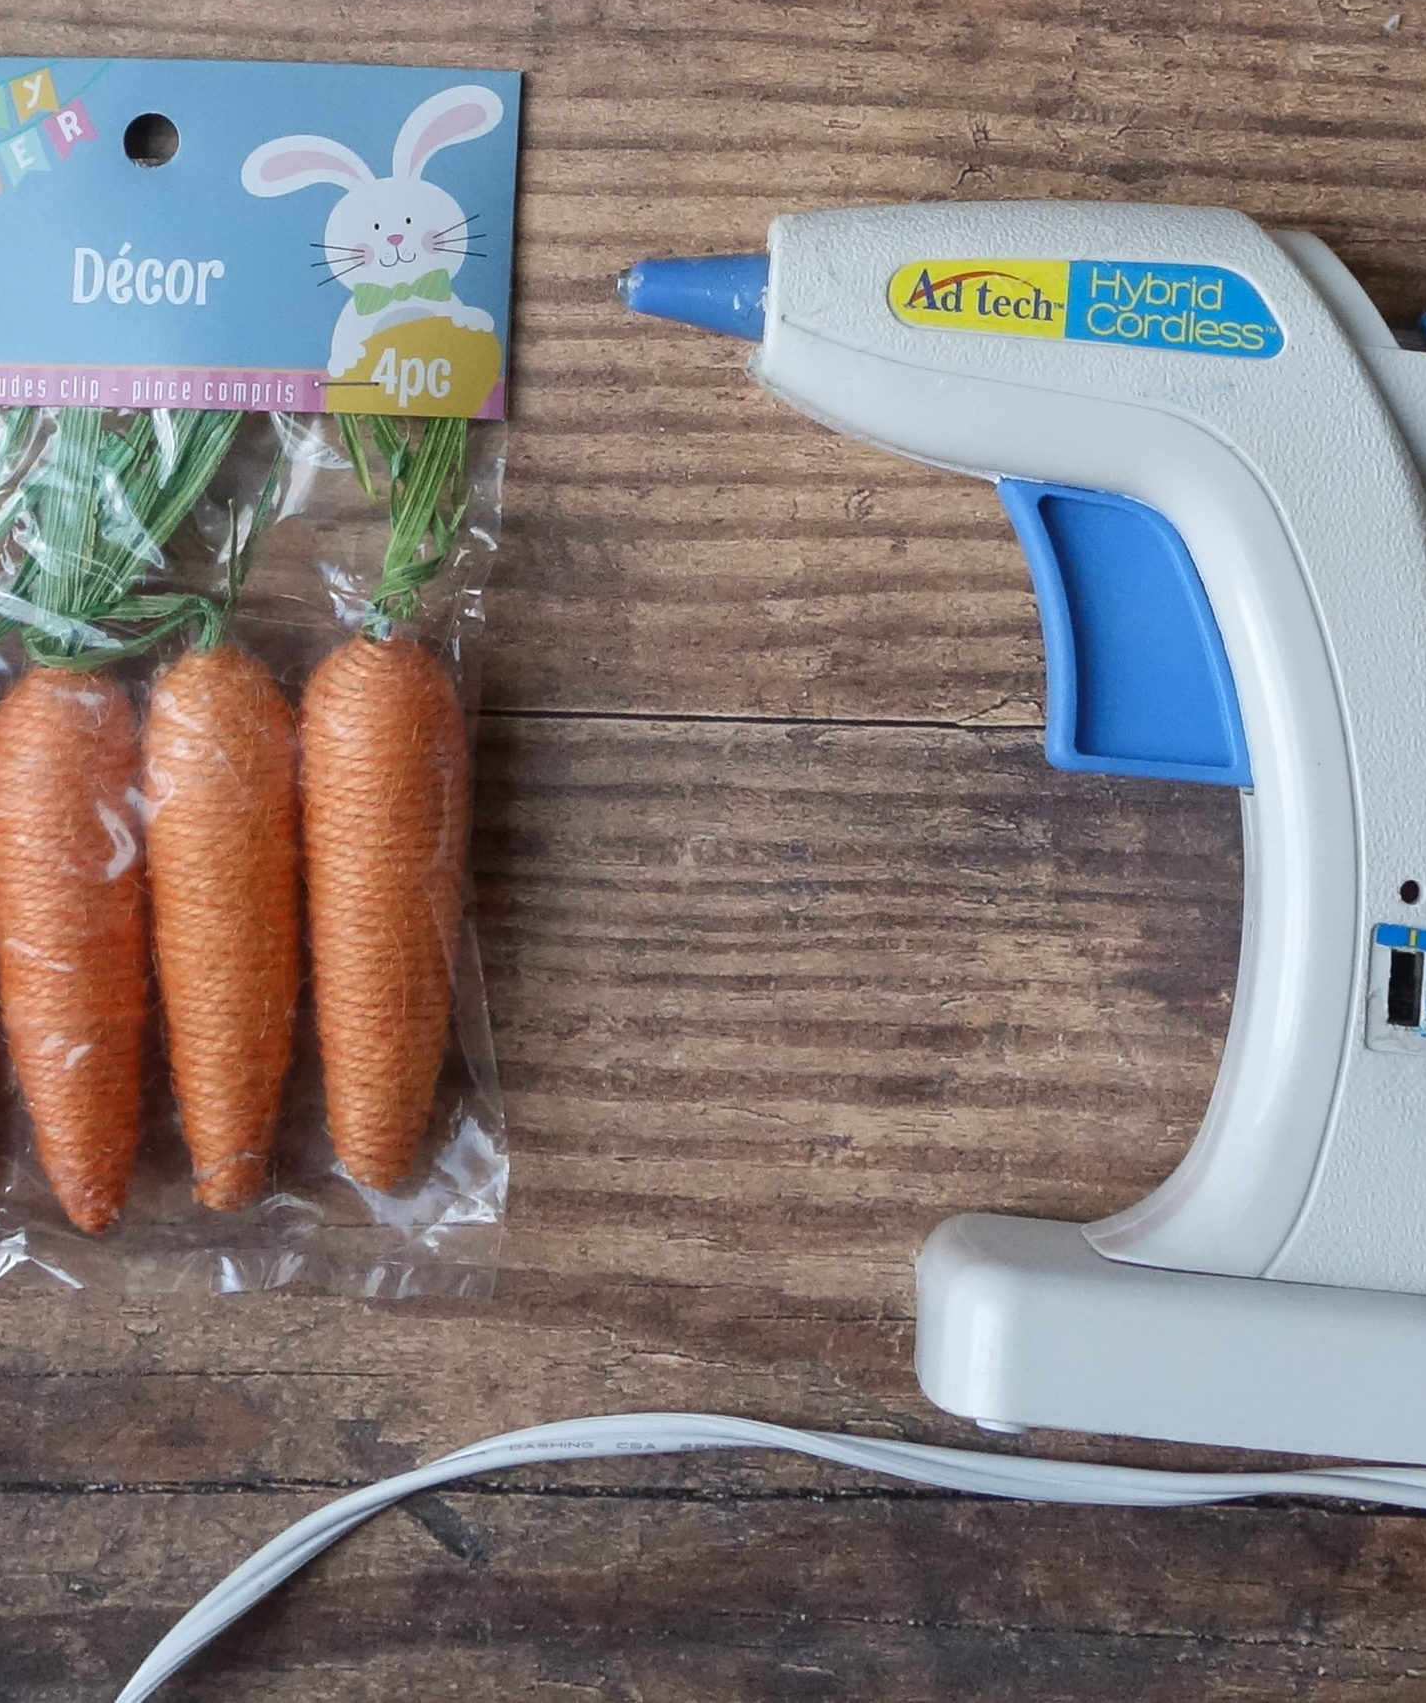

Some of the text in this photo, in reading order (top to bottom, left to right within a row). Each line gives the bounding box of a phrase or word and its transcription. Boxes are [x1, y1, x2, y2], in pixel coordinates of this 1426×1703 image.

[73, 243, 225, 307] Décor
[904, 268, 1053, 321] Ad tech
[1092, 267, 1224, 311] Hybrid
[1086, 302, 1265, 349] Cordless
[60, 375, 99, 403] clip
[131, 375, 191, 404] pince
[203, 379, 296, 406] compris
[376, 347, 452, 405] 4pc
